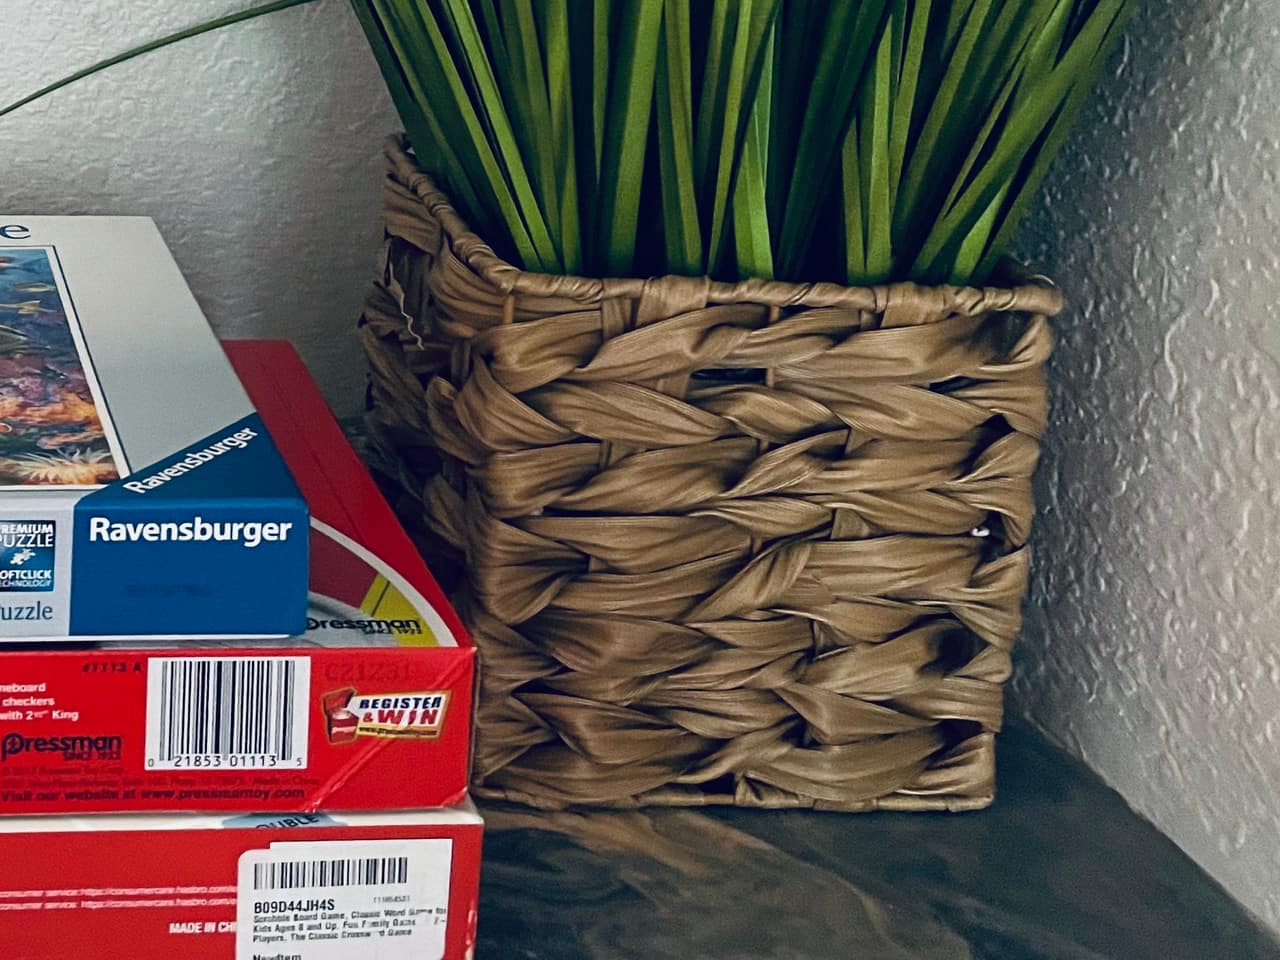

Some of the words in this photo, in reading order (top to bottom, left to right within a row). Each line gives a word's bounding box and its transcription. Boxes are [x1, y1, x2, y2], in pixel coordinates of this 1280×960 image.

[123, 427, 258, 493] Ravensburger
[90, 517, 292, 547] Ravensburger
[2, 696, 55, 707] checkers
[359, 697, 442, 709] REGISTER
[0, 709, 23, 720] with
[52, 710, 79, 722] King
[378, 709, 438, 725] WIN
[174, 755, 221, 767] 21853
[230, 755, 276, 767] 01113
[296, 757, 303, 767] 5
[254, 899, 335, 914] B09D44JH4S
[170, 923, 203, 933] MADE
[362, 920, 389, 928] Fmily
